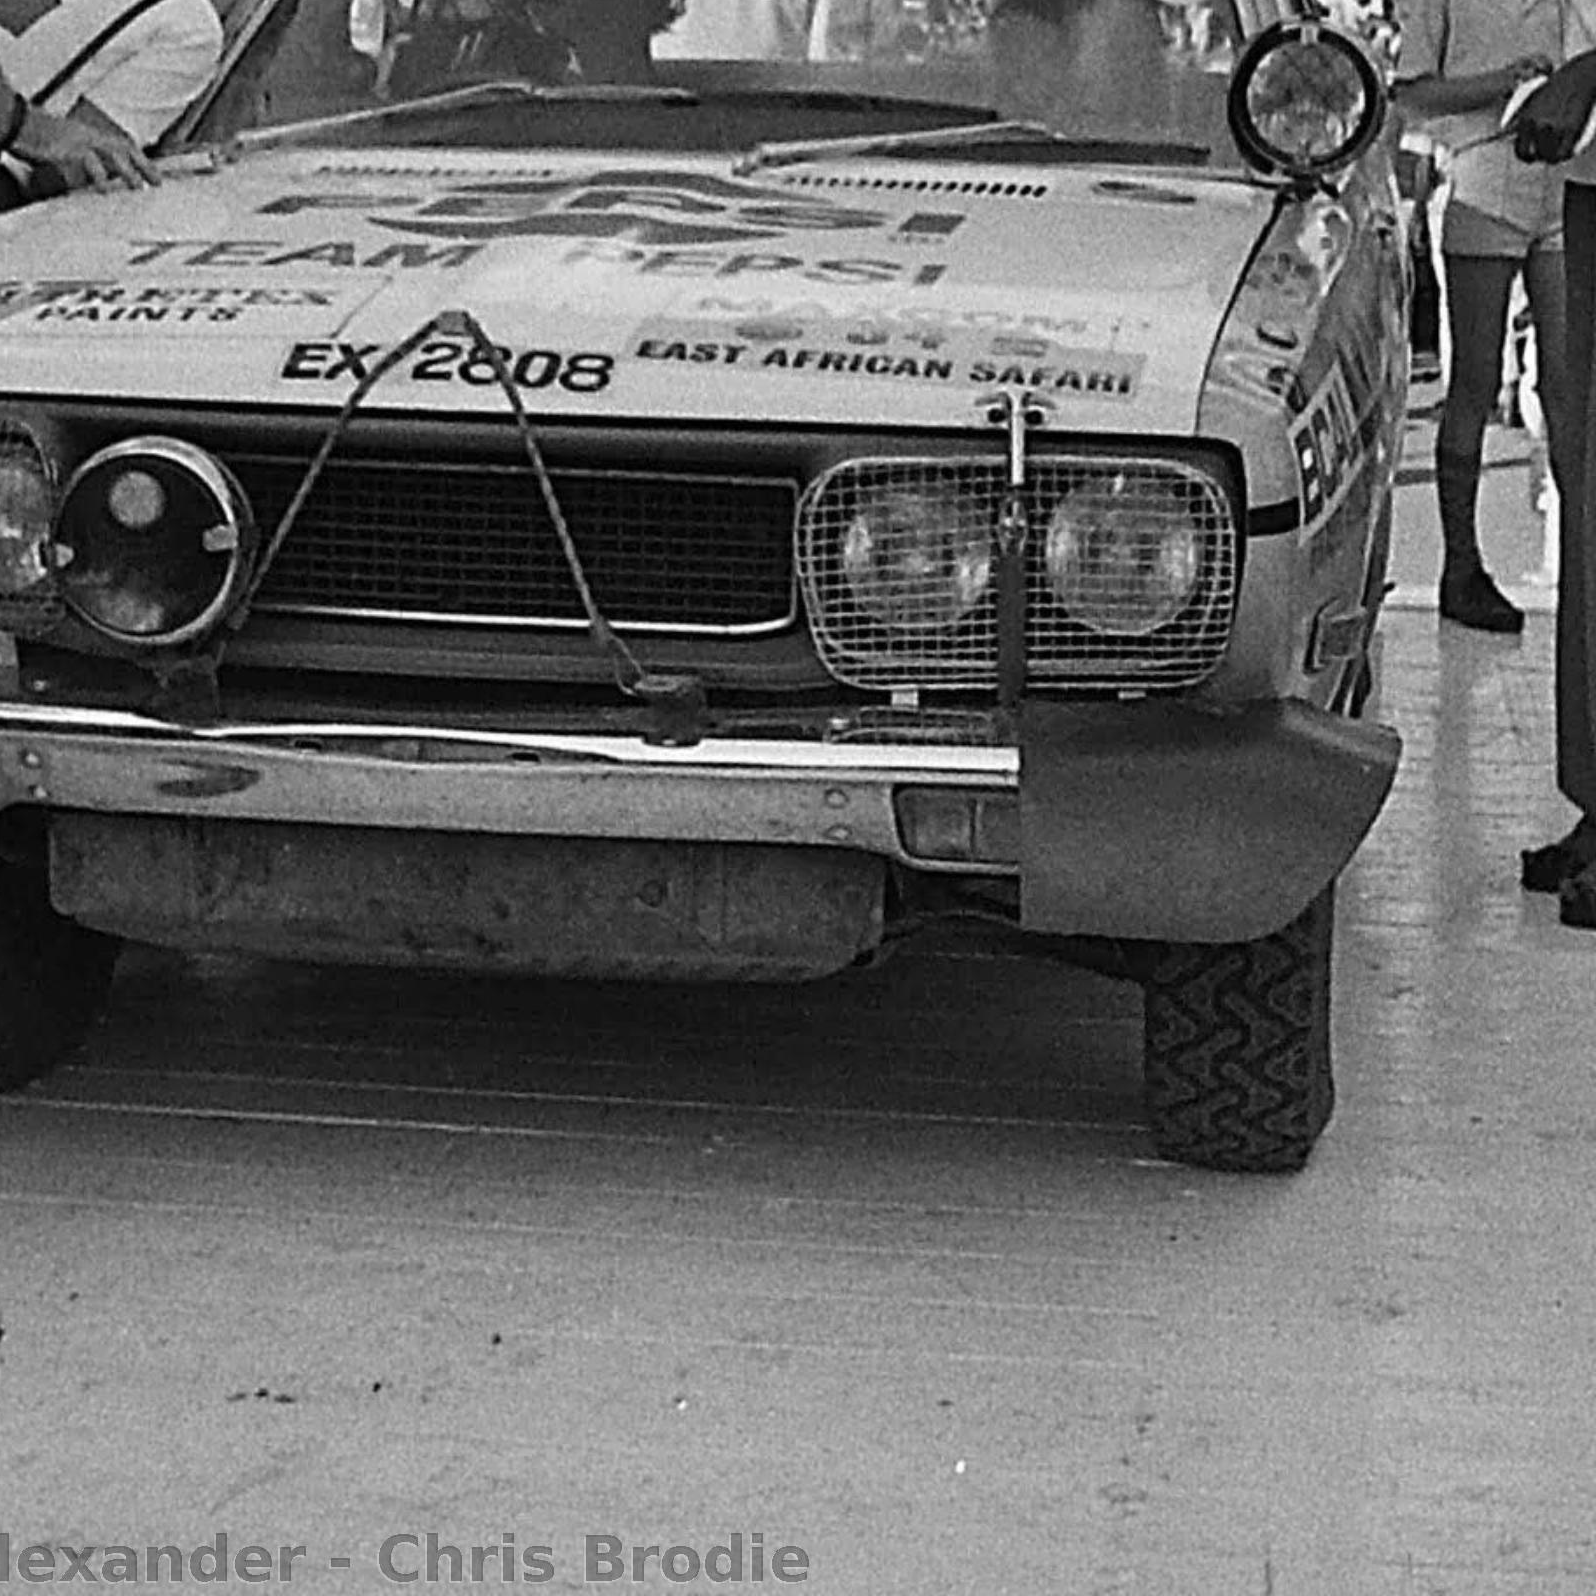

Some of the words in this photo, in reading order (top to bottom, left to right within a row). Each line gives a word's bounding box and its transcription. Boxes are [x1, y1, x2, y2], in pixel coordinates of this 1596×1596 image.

[129, 240, 486, 269] TEAM
[281, 342, 380, 381] EX
[410, 341, 616, 393] 2808
[634, 338, 749, 365] EAST
[760, 347, 954, 381] AFRICAN
[969, 358, 1134, 394] SAFARI
